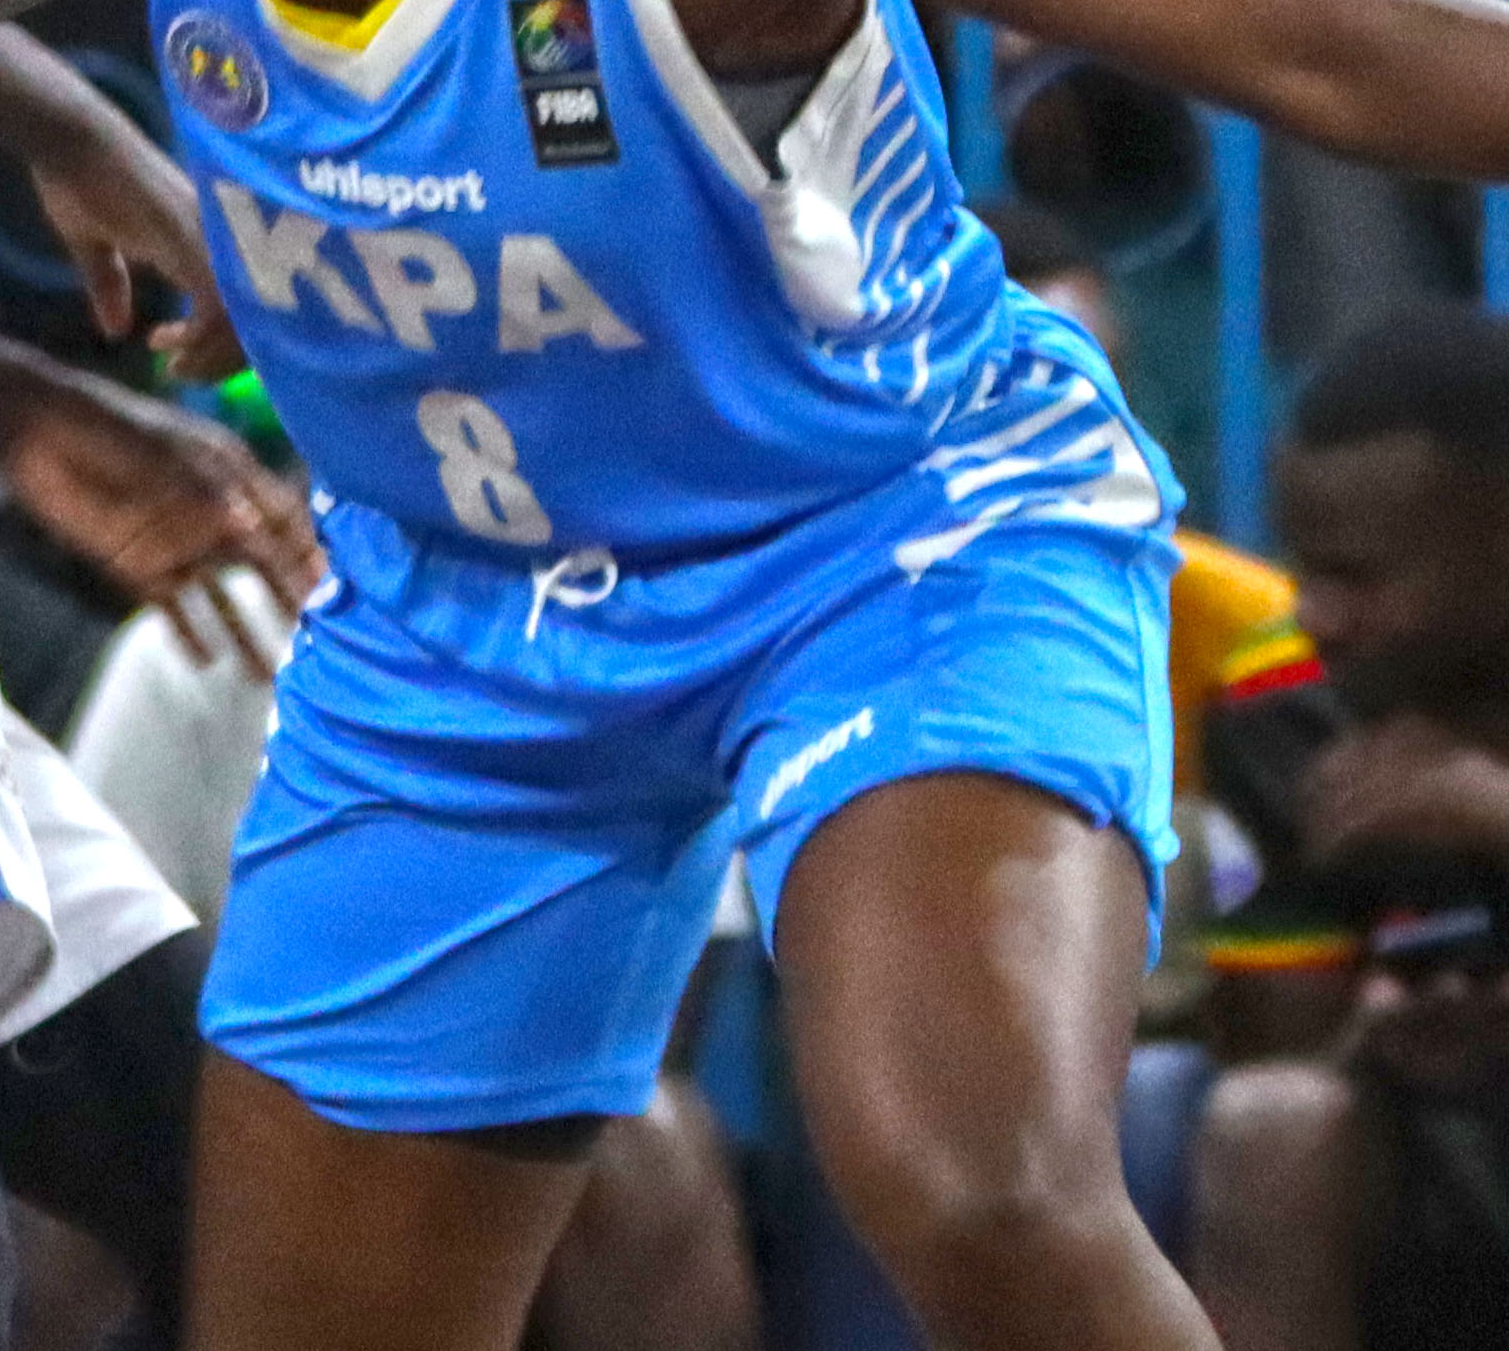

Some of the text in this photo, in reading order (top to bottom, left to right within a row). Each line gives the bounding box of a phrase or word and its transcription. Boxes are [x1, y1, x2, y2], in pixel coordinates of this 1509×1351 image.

[211, 177, 646, 353] KPA
[299, 157, 487, 218] uhlsport
[416, 390, 553, 546] 8
